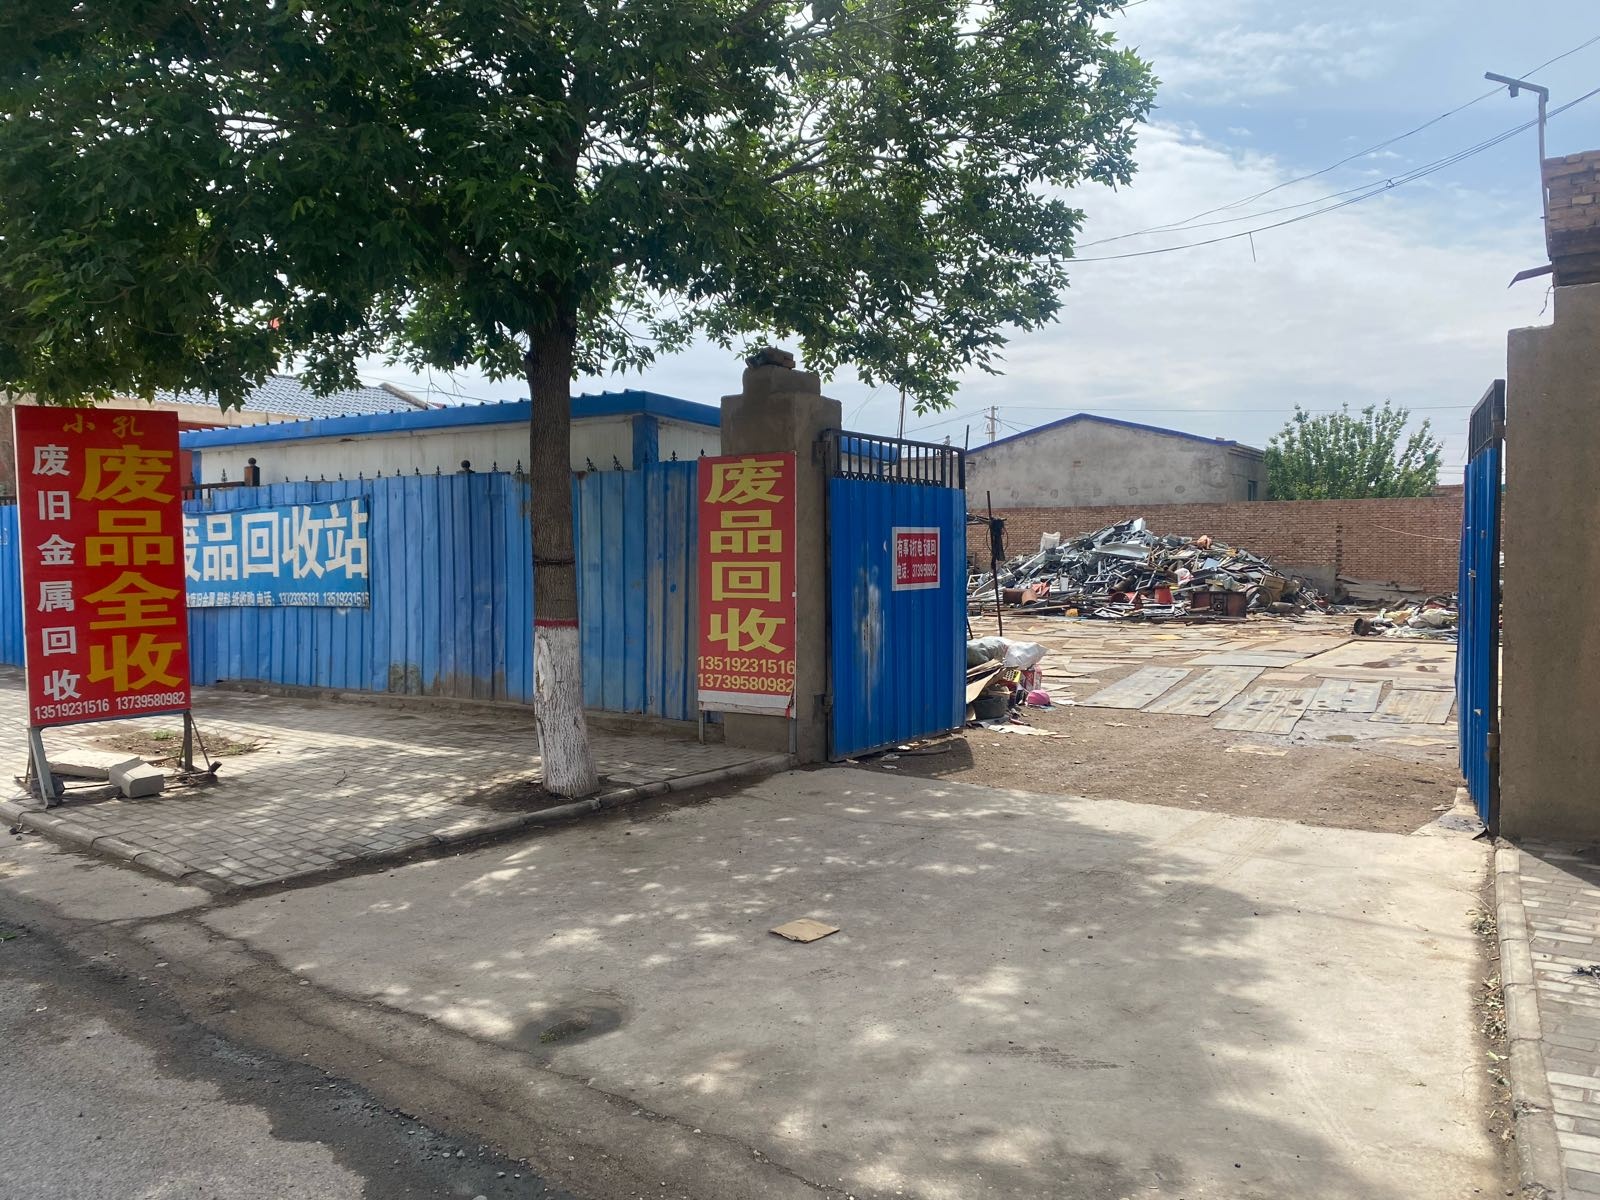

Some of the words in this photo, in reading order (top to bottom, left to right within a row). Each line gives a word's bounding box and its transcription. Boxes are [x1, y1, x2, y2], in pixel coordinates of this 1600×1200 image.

[63, 413, 144, 439] 小孔
[77, 444, 183, 692] 废品全收
[705, 458, 786, 654] 废品回收
[32, 444, 82, 702] 废旧金属回收
[698, 655, 796, 677] 13519231516
[698, 673, 796, 694] 13739580982
[34, 698, 110, 720] 13519231516
[115, 691, 185, 712] 13739580982
